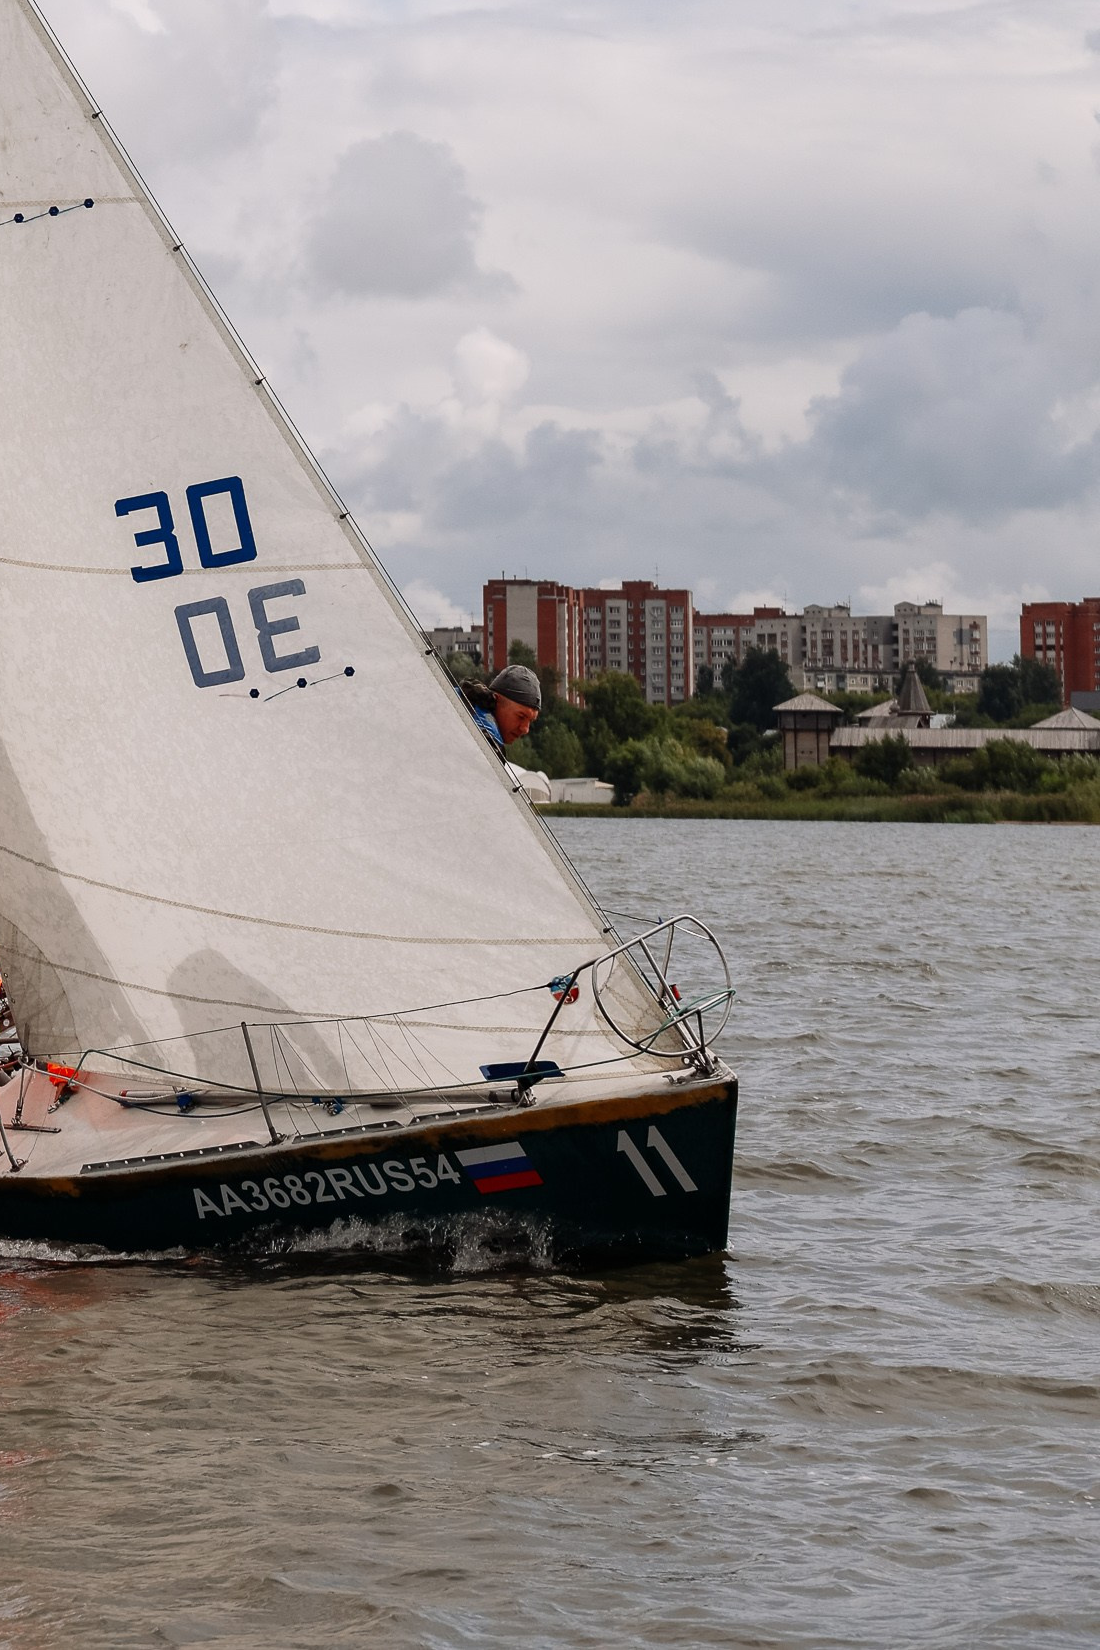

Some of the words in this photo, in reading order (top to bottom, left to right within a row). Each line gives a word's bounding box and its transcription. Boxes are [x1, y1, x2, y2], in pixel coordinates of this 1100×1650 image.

[114, 475, 258, 583] 30
[192, 1153, 461, 1219] AA3682RUS54
[616, 1124, 699, 1197] 11
